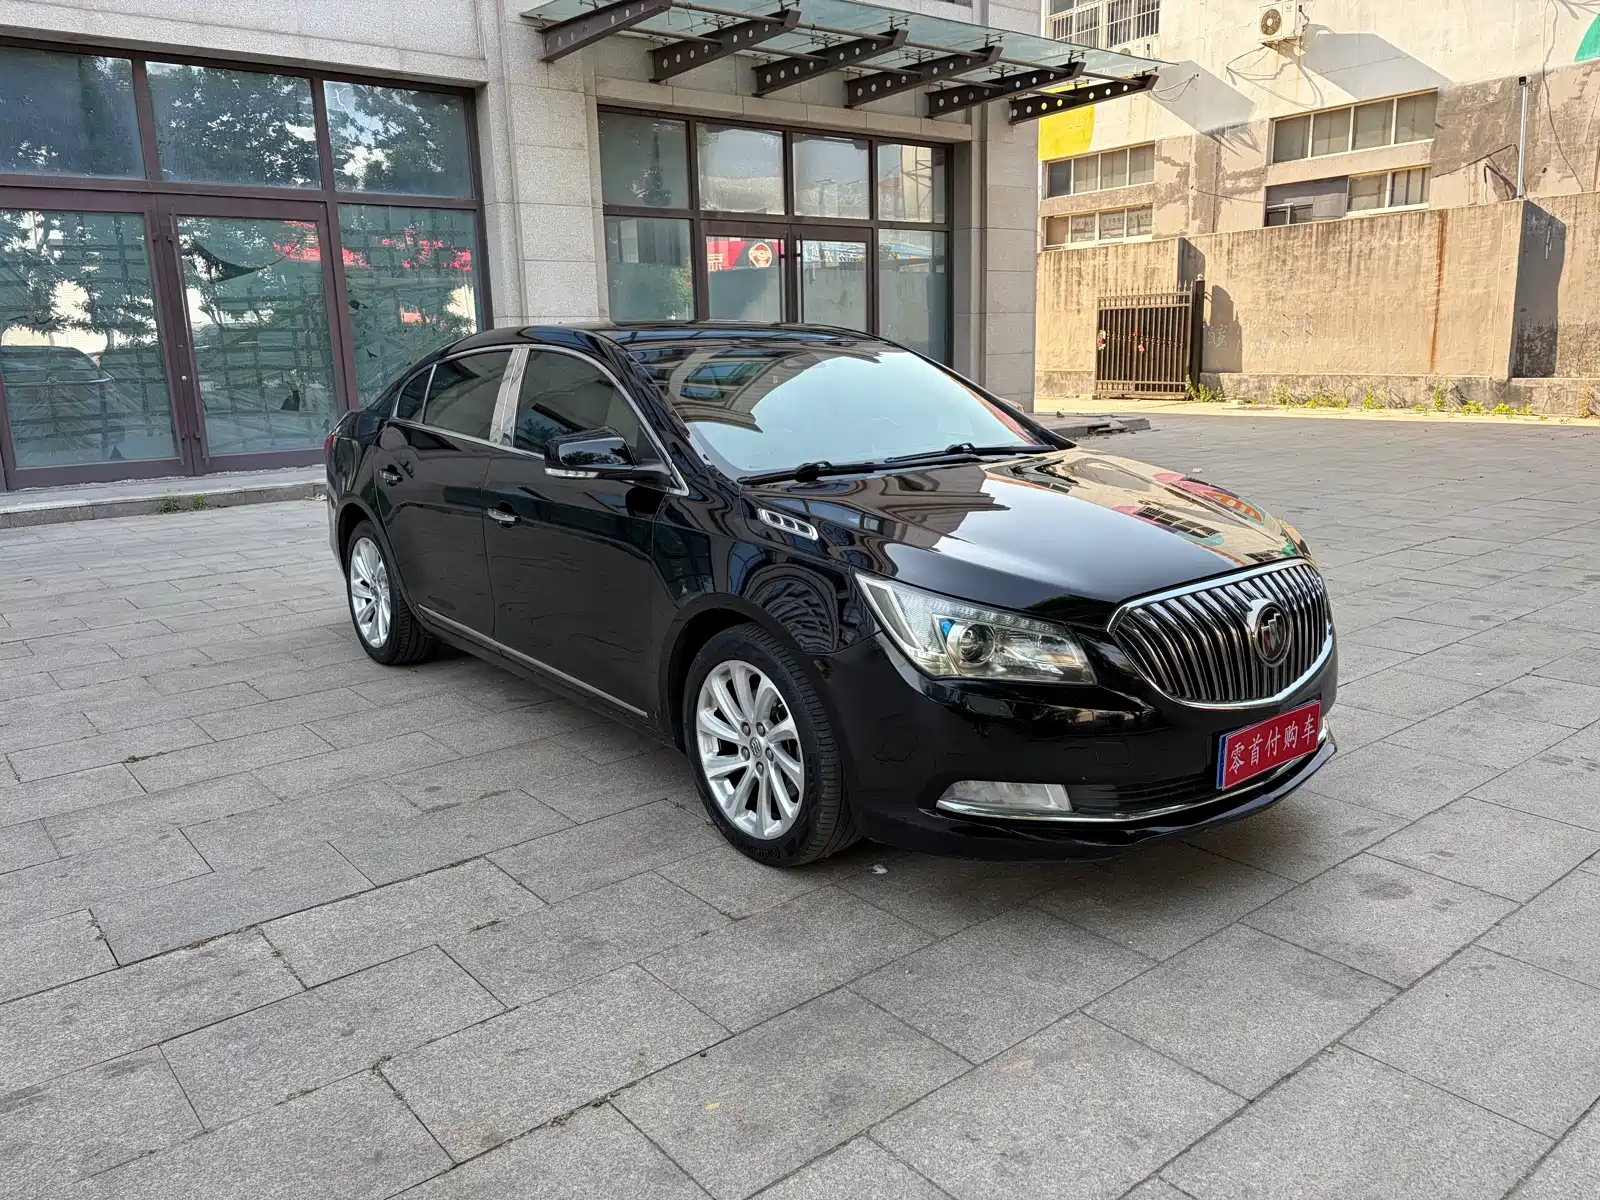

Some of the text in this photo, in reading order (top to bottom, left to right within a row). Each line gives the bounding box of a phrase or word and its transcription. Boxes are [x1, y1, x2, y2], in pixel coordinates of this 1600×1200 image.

[1228, 713, 1316, 775] 零首付购车
